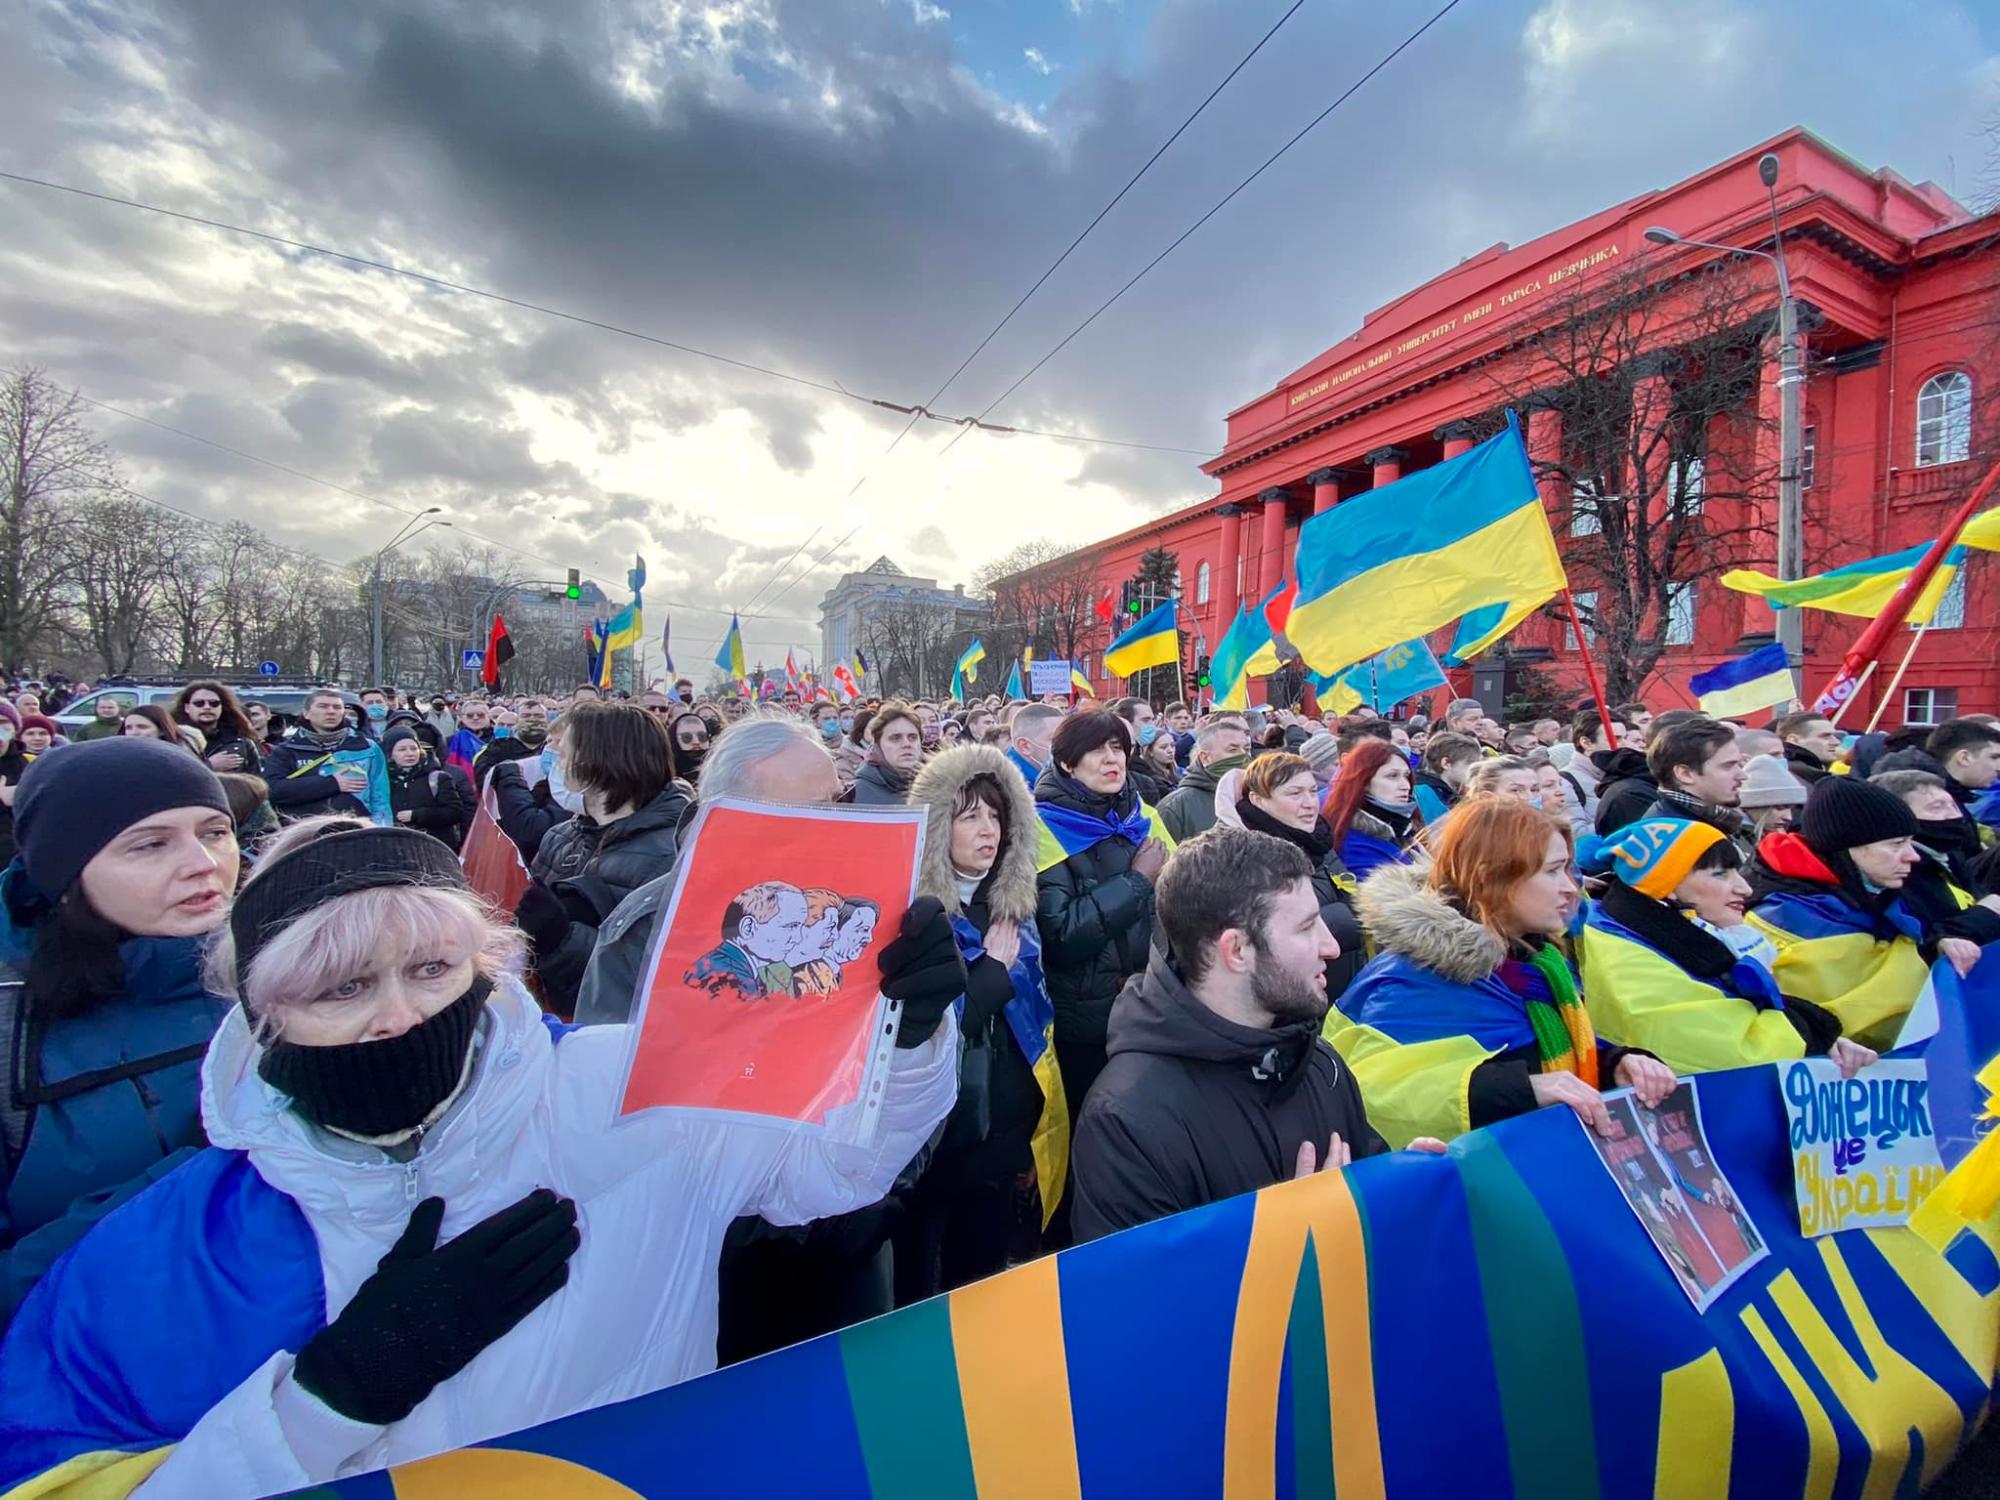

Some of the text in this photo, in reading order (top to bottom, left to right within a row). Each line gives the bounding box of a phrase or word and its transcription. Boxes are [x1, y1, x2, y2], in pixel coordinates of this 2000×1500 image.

[1463, 303, 1492, 324] ІМЕНІ
[1499, 281, 1542, 307] ТАРАСА
[1548, 244, 1620, 285] ШЕВЧЕНКА
[1611, 823, 1679, 868] UA
[1786, 1062, 1933, 1150] Донецьк
[1797, 1152, 1946, 1235] Україн
[1833, 1138, 1866, 1175] це
